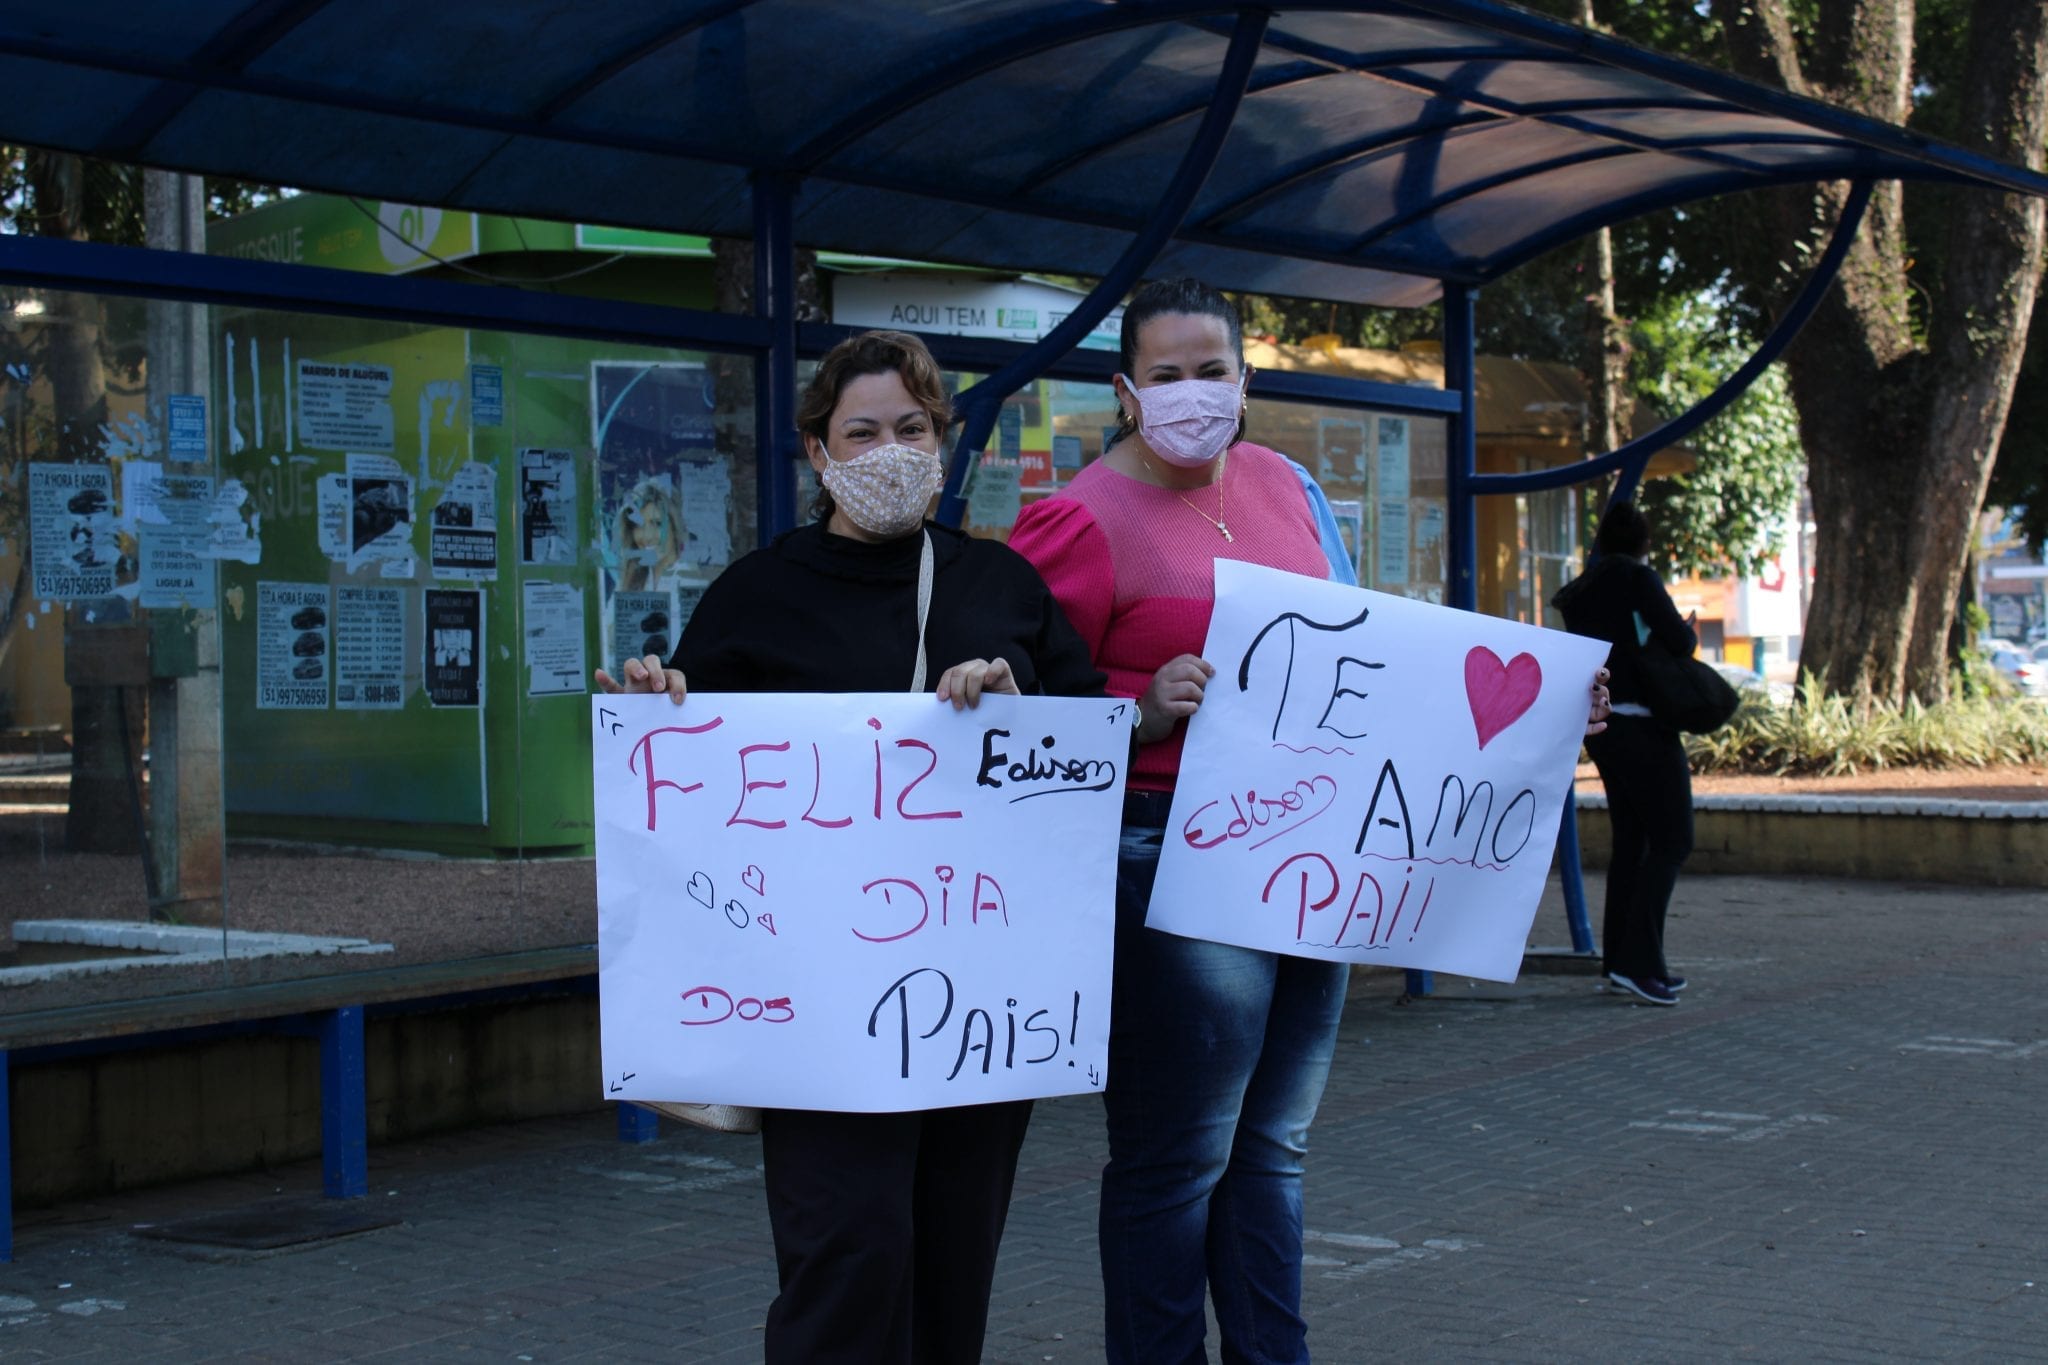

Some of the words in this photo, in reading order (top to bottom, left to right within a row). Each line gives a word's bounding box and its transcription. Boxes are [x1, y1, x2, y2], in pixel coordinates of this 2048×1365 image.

[890, 304, 939, 325] AQUI
[945, 307, 986, 327] TEM
[302, 365, 336, 378] MARIDO
[339, 367, 351, 378] DE
[352, 368, 390, 381] ALUGUEL
[51, 473, 74, 488] HORA
[81, 474, 107, 488] AGORA
[156, 578, 182, 588] LIGUE
[278, 592, 296, 603] HORA
[303, 593, 326, 605] AGORA
[1238, 608, 1386, 741] TE
[260, 687, 327, 706] (51)997506958
[976, 728, 1116, 798] Edison
[1183, 774, 1337, 851] Edison
[1355, 758, 1536, 867] AMO
[851, 865, 1009, 944] DIA
